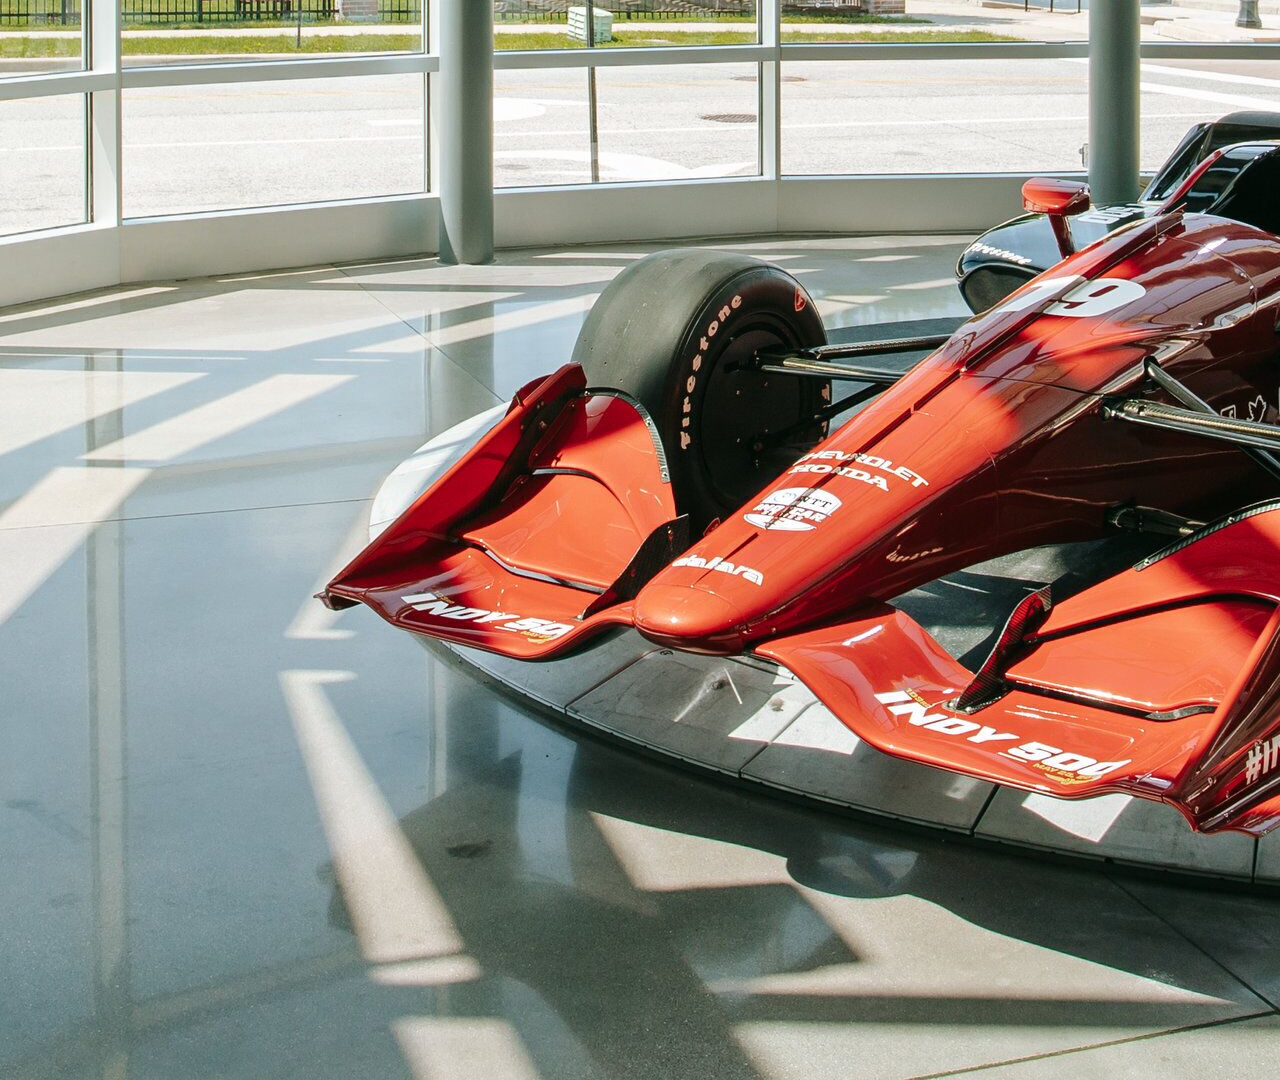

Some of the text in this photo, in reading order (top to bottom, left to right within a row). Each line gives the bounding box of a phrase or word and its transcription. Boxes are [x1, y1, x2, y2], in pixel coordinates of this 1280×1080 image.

[966, 242, 1032, 265] Firestone
[680, 294, 742, 450] Firestone
[787, 463, 890, 492] HONDA
[671, 553, 765, 587] dallara
[400, 592, 521, 623] INDY
[495, 617, 576, 638] 50
[874, 690, 1133, 777] INDY 500
